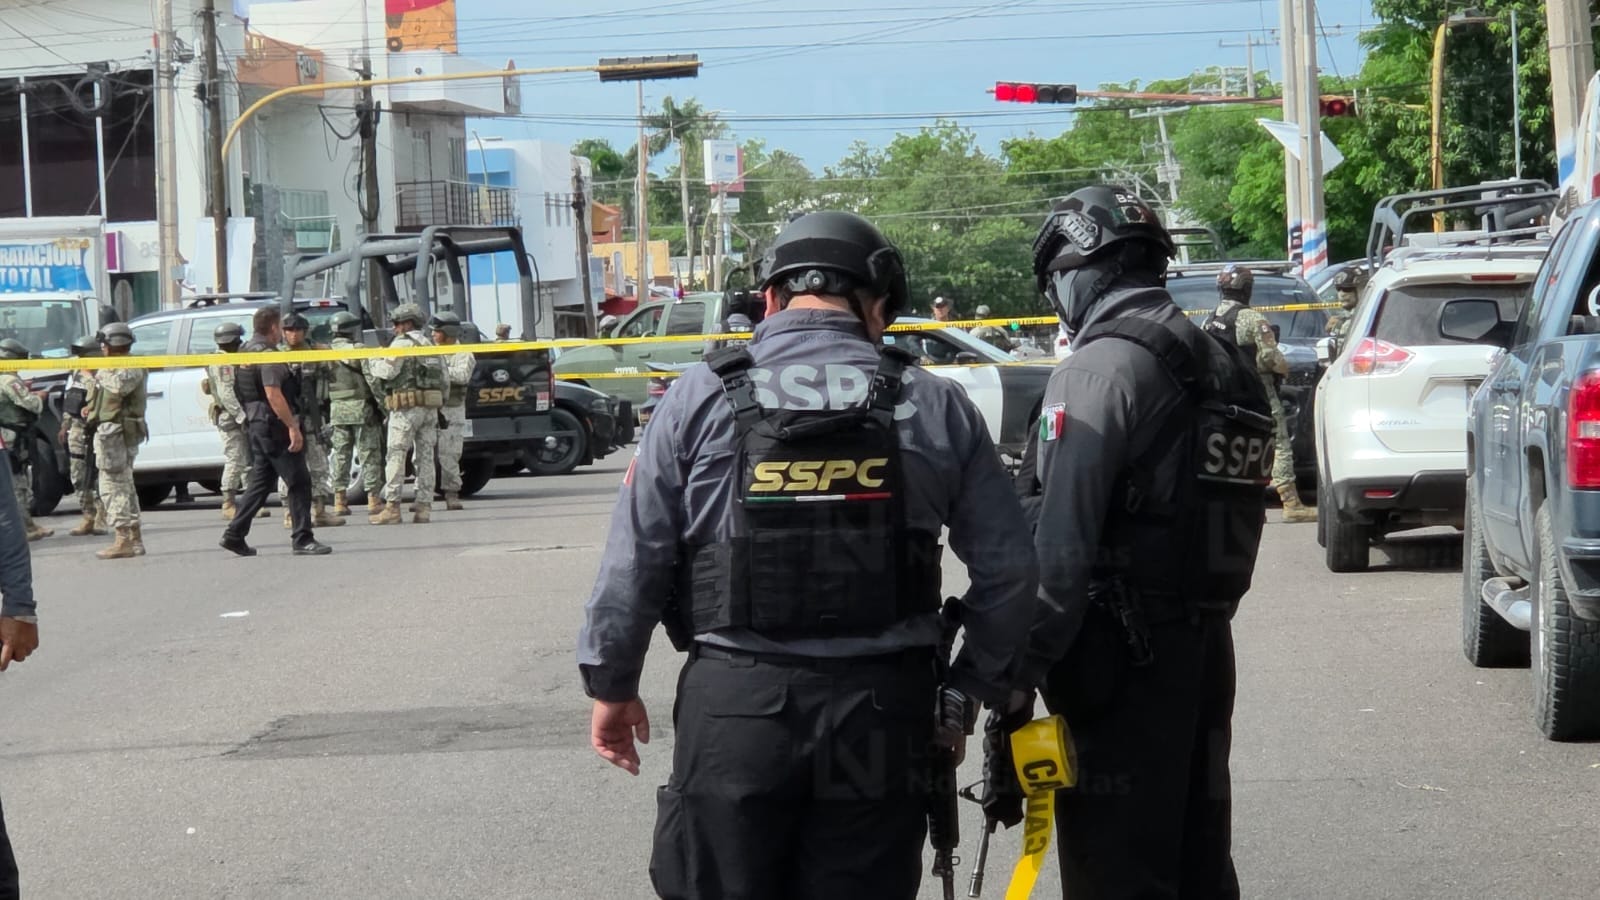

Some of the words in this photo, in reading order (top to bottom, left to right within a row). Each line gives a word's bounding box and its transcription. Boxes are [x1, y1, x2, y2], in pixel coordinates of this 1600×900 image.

[0, 267, 53, 289] TOTAL
[478, 386, 525, 401] SSPC
[747, 363, 919, 421] SSP
[1203, 432, 1275, 477] SSPC
[749, 458, 889, 492] SSPC
